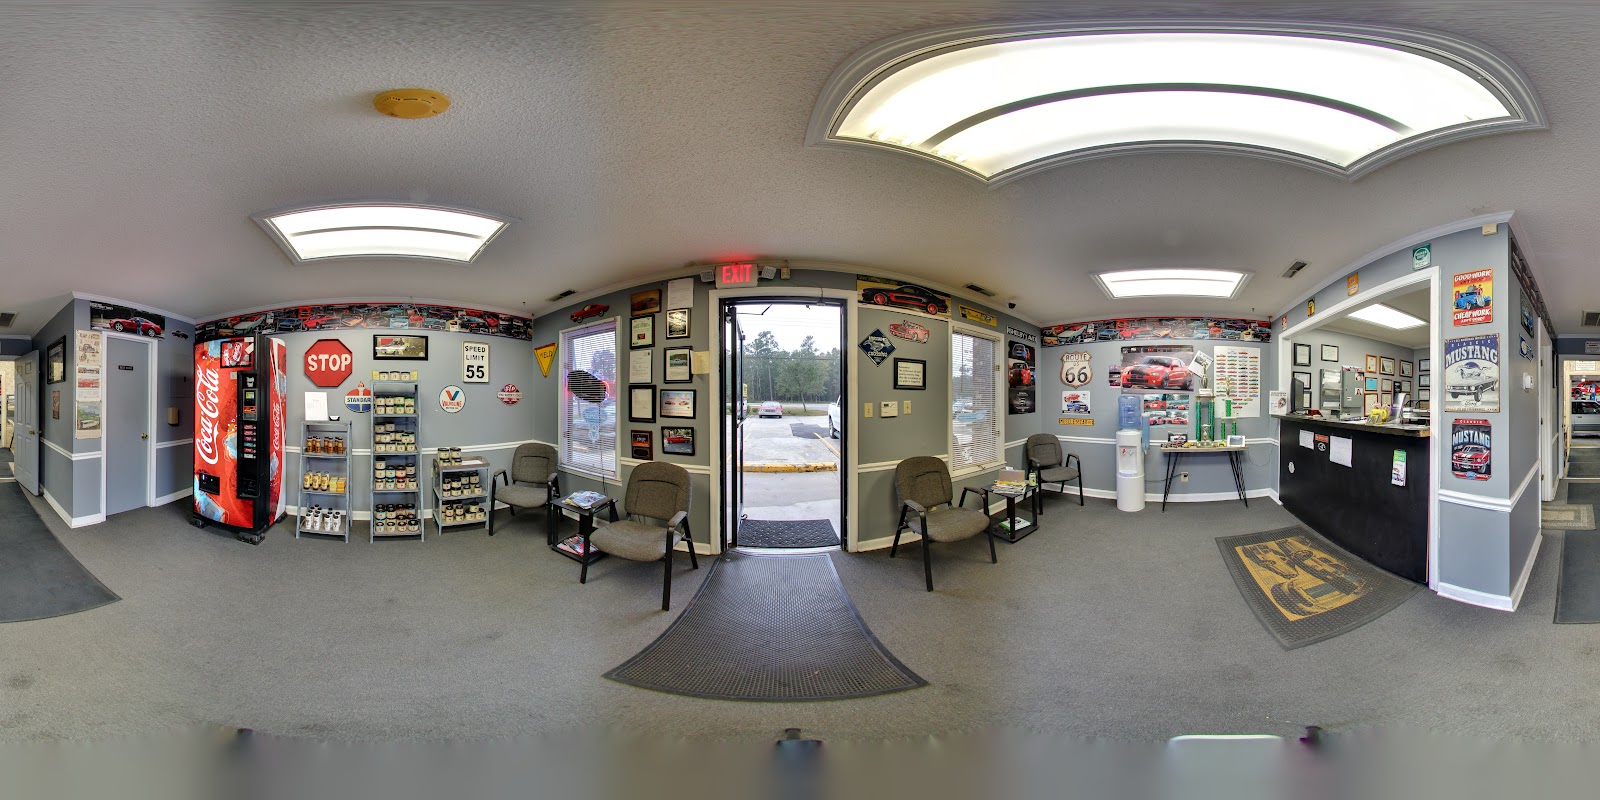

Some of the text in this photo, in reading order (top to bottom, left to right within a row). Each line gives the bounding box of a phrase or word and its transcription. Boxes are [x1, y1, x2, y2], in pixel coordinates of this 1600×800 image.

[722, 264, 752, 284] EXIT
[1455, 273, 1471, 282] GOOD
[1454, 311, 1471, 320] CHEAP
[465, 345, 486, 353] SPEED
[1451, 339, 1491, 348] CLASSIC
[539, 350, 553, 359] YIELD
[1065, 353, 1087, 361] ROUTE
[1446, 346, 1498, 367] MUSTANG
[307, 354, 351, 372] STOP
[466, 365, 485, 379] 55
[1065, 366, 1088, 383] 66
[1453, 430, 1491, 448] MUSTANG
